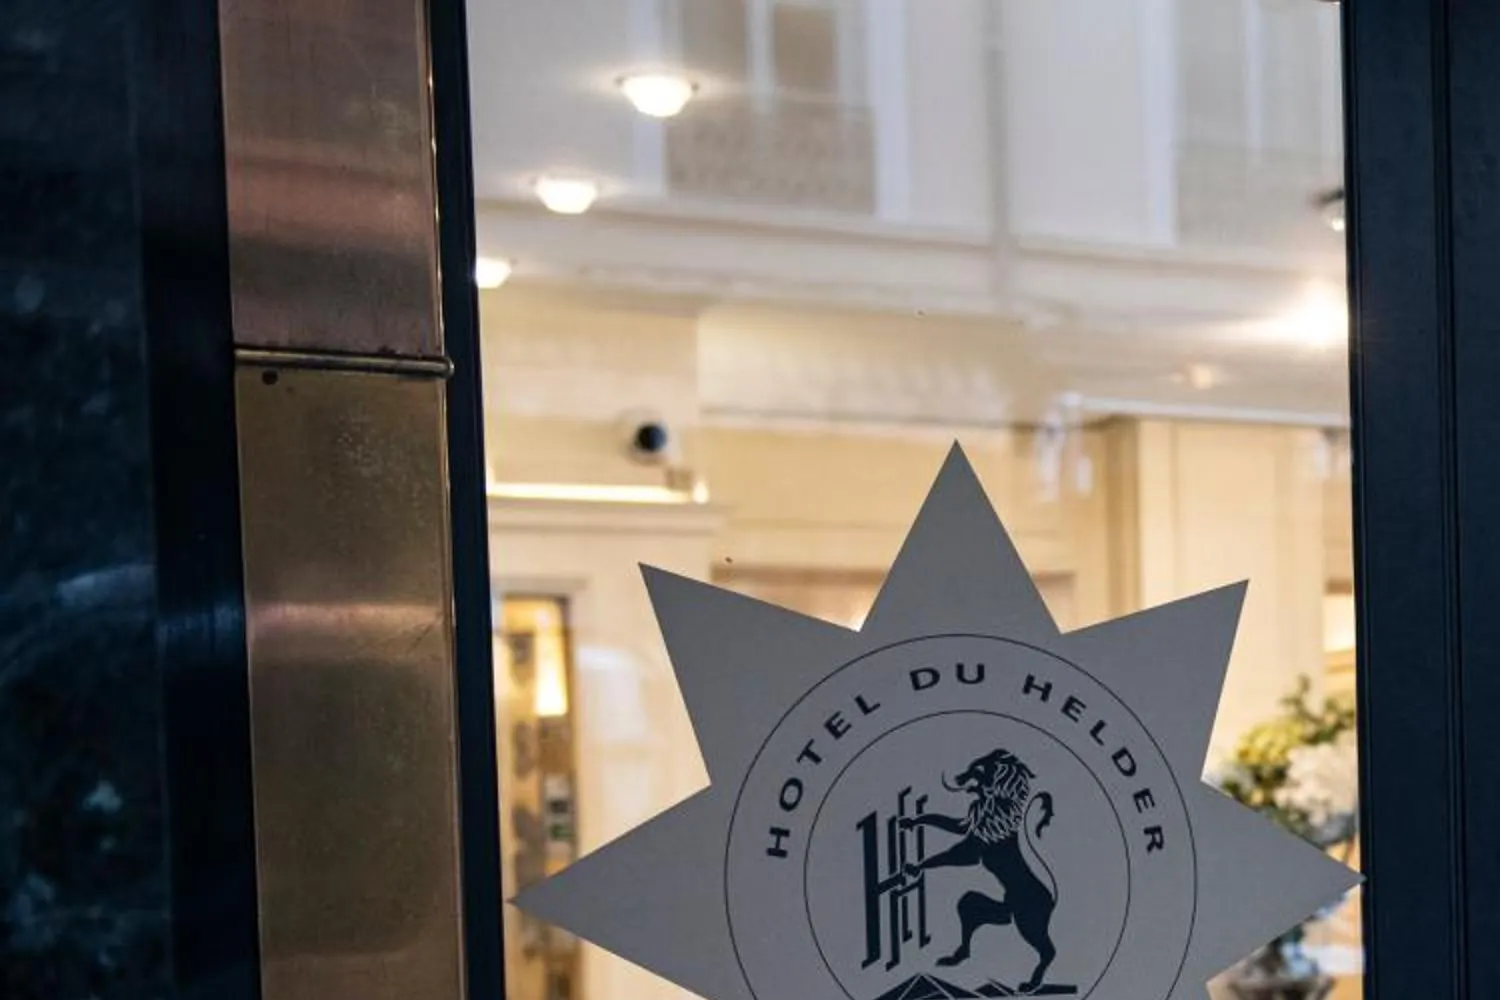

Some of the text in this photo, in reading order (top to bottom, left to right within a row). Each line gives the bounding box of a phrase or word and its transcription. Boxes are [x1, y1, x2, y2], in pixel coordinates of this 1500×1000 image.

[765, 662, 1165, 859] HOTEL DU HELDER
